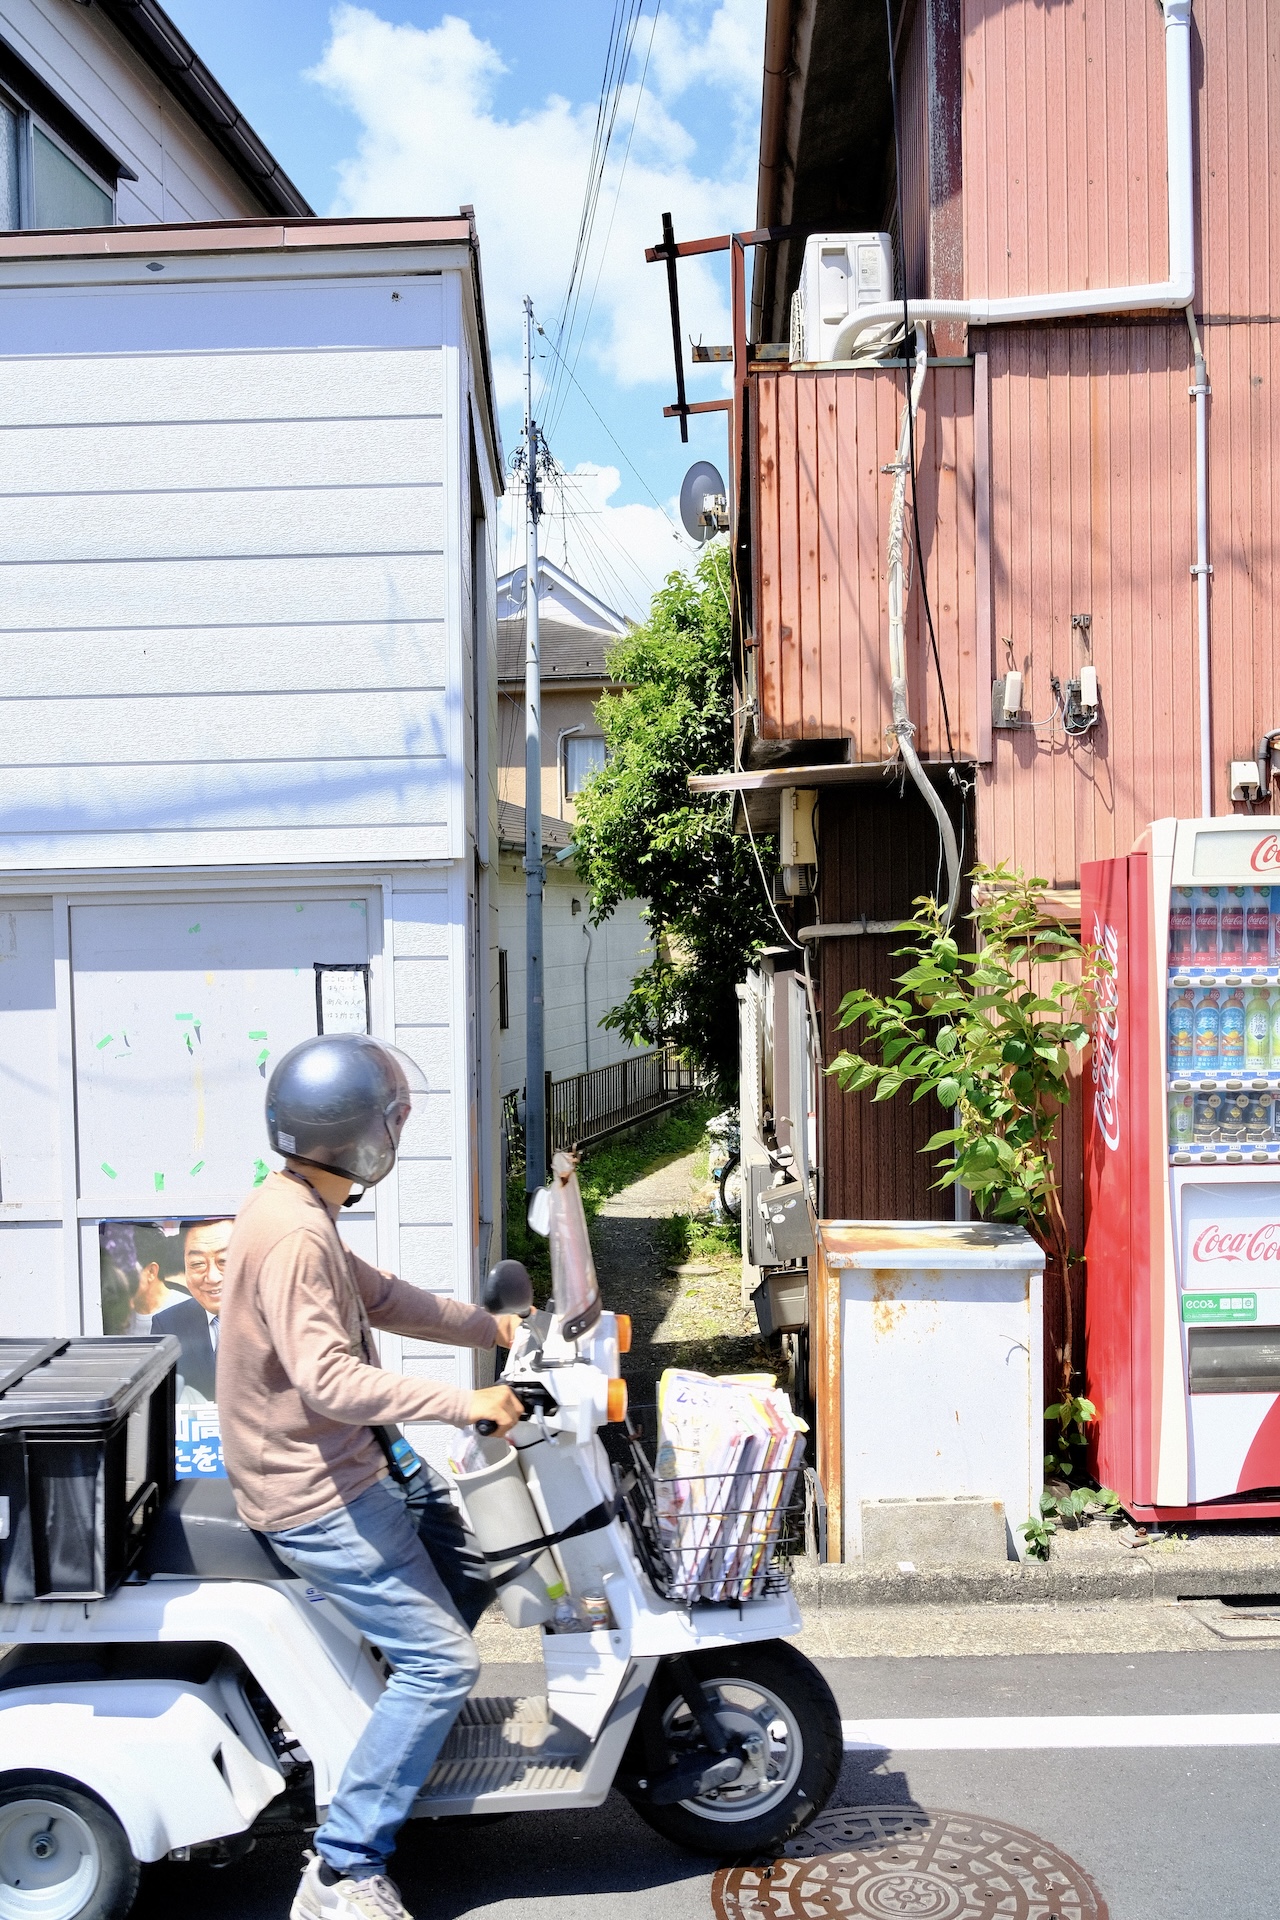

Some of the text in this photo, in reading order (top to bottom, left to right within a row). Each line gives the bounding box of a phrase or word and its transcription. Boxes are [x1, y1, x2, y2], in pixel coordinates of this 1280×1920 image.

[1250, 834, 1280, 872] Co
[1093, 910, 1119, 1151] Coca-Cola
[1196, 1016, 1218, 1029] 麦茶
[1192, 1224, 1280, 1263] Coca-Co
[175, 1445, 226, 1473] たを
